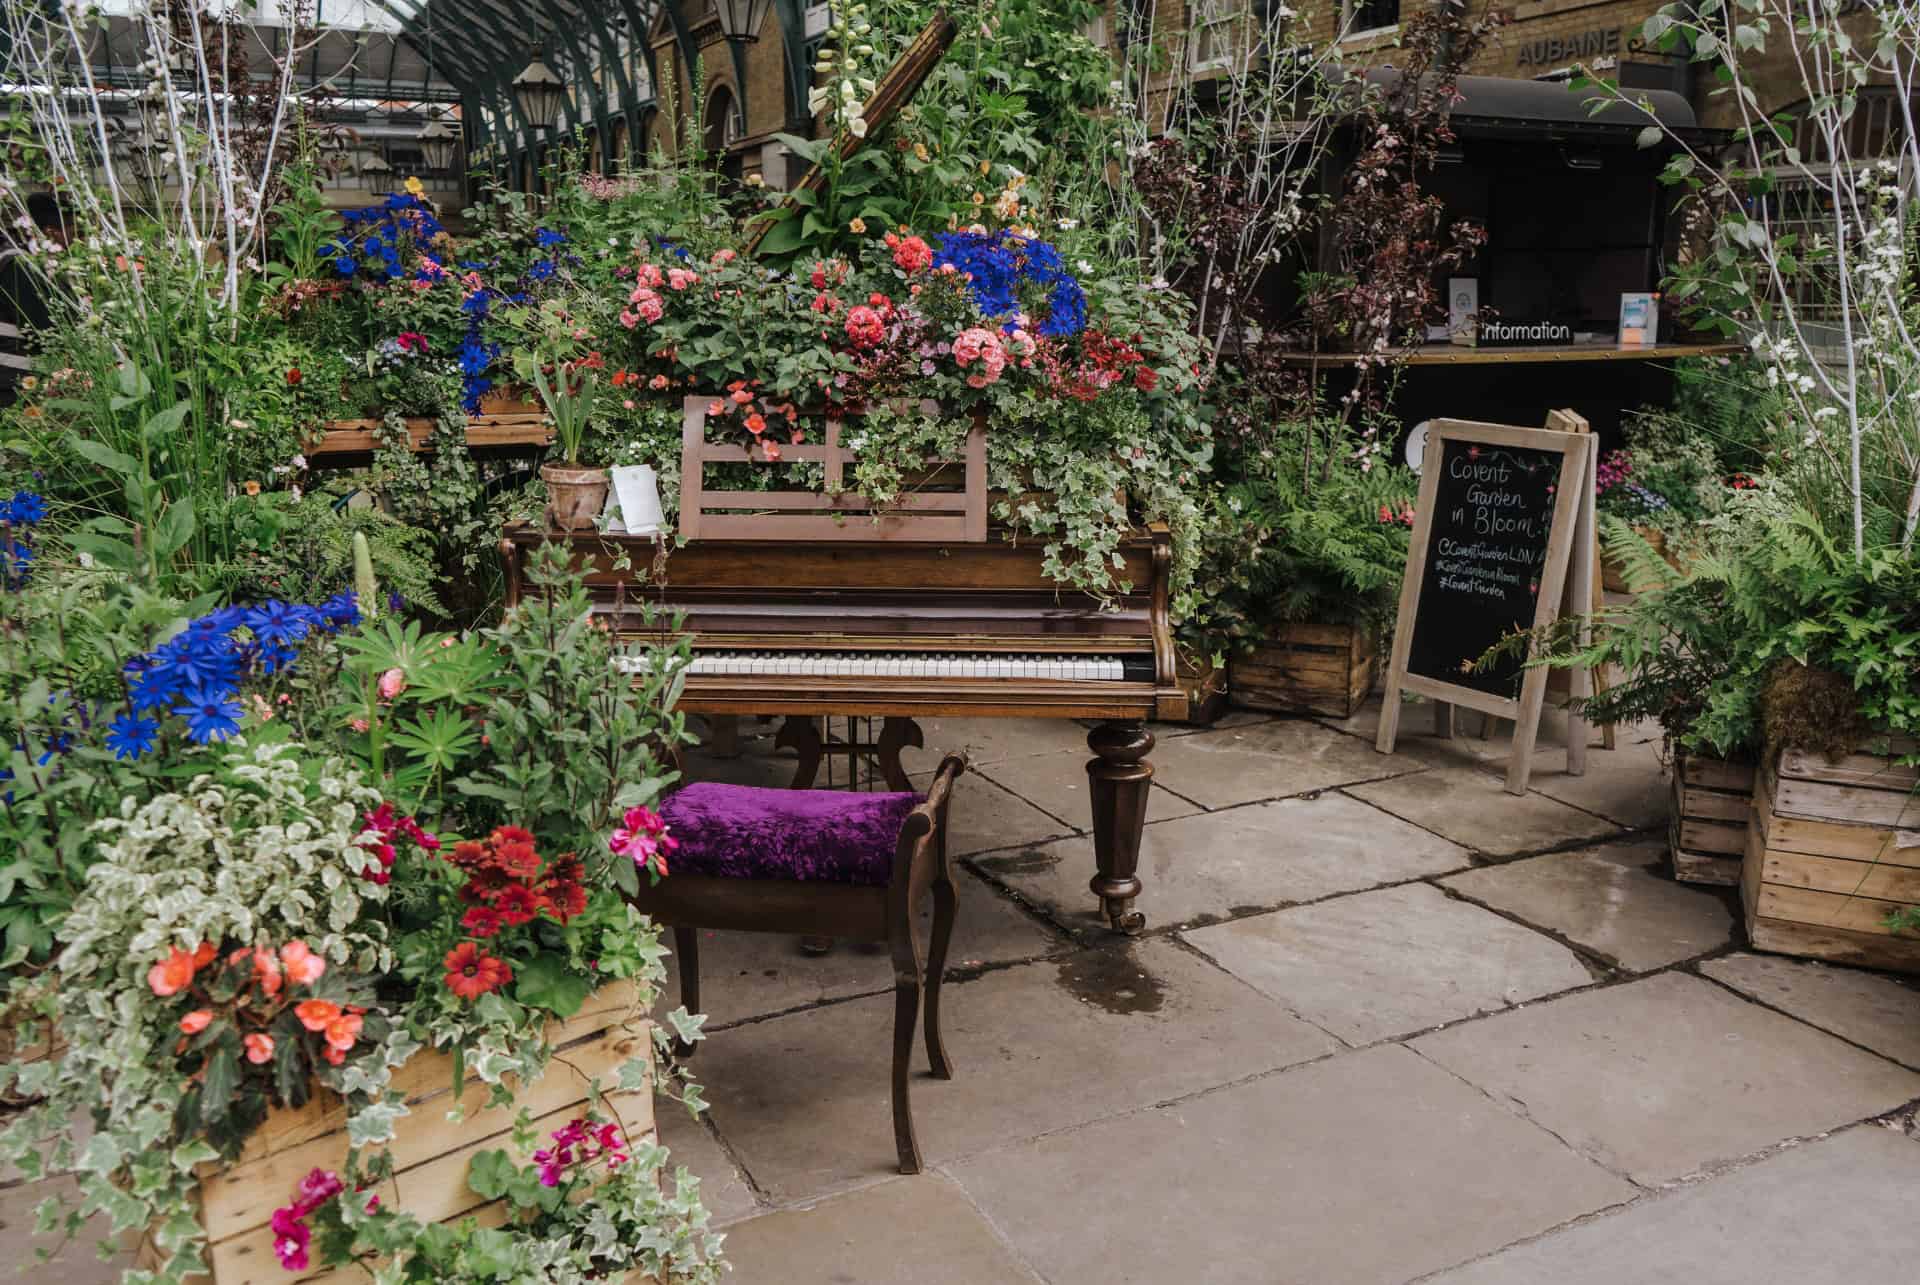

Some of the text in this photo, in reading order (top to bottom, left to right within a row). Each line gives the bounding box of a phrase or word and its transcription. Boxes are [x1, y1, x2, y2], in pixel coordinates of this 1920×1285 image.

[1517, 29, 1621, 66] AUBAINE
[1450, 456, 1512, 483] Covent
[1466, 484, 1526, 508] Garden
[1452, 507, 1464, 526] in
